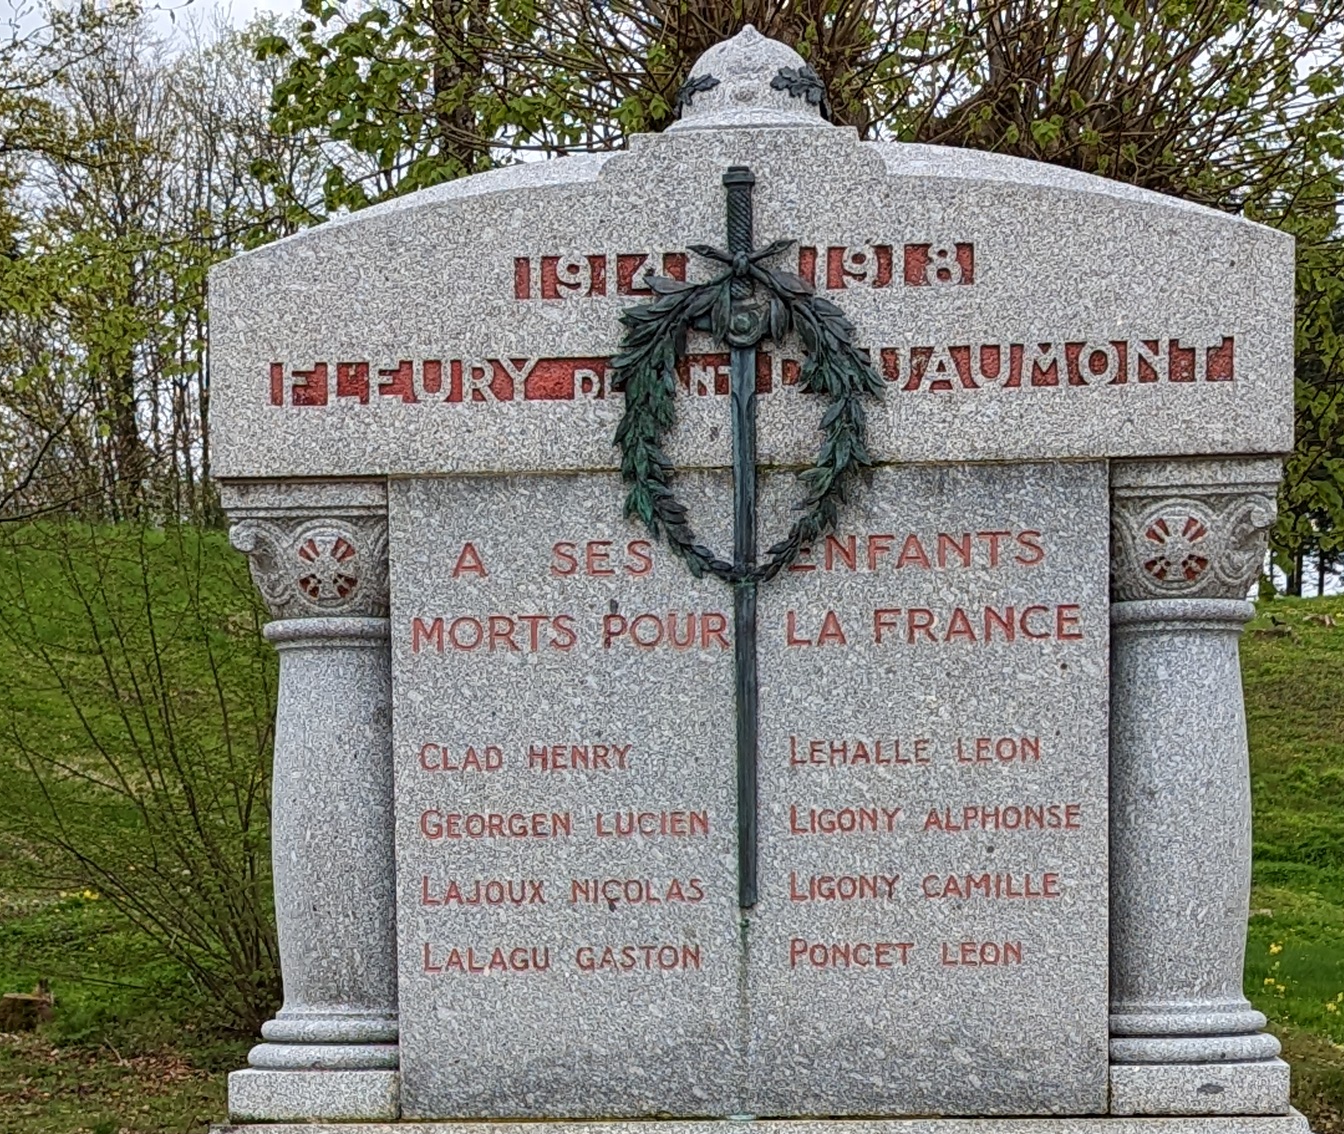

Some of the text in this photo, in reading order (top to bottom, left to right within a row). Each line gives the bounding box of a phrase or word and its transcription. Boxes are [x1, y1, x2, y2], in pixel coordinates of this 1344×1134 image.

[806, 243, 967, 291] 1918
[274, 358, 541, 405] FLEURY
[771, 338, 1230, 396] DUAUMONT
[453, 541, 487, 577] A
[553, 539, 653, 576] SES
[411, 603, 1084, 653] MORTS POUR LA FRANCE
[419, 743, 632, 772] CLAD HENRY
[790, 736, 1042, 766] LEHALLE LEON
[420, 809, 710, 839] GEORGEN LUCIEN
[790, 804, 1082, 834] LIGONY ALPHONSE
[421, 875, 705, 906] LAJOUX NICOLAS
[790, 872, 1062, 901] LIGONY CAMILLE
[423, 943, 702, 972] LALAGU GASTON
[790, 938, 1023, 969] PONCET LEON
